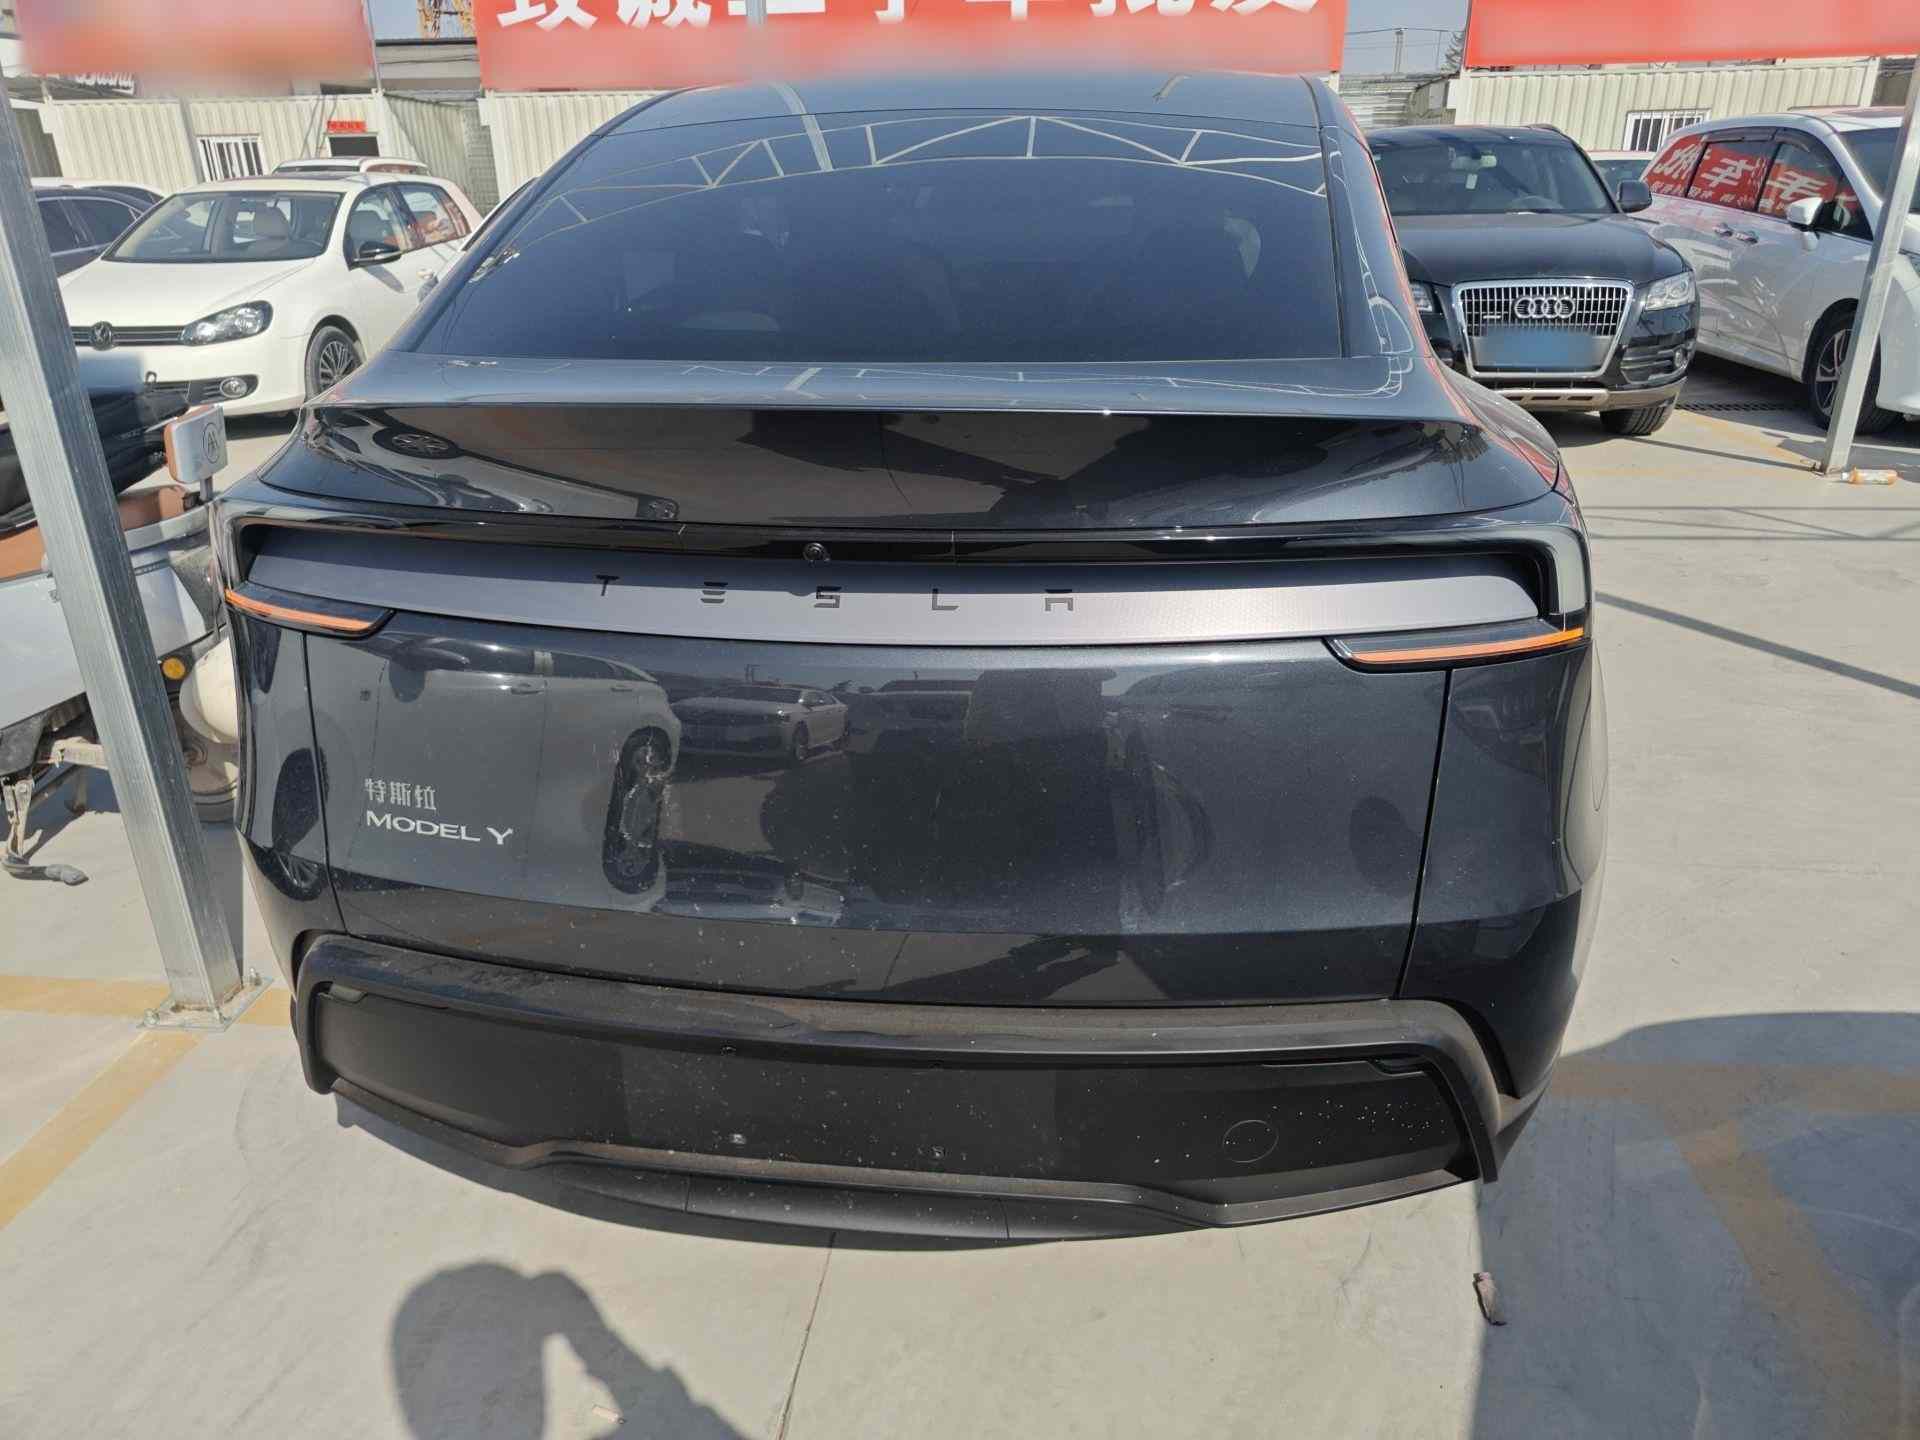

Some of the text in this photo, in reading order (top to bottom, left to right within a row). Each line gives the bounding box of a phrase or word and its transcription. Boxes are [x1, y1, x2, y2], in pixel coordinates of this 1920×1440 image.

[596, 574, 1074, 613] TESLA
[365, 778, 436, 810] 特斯拉
[366, 810, 514, 845] MODEL Y
